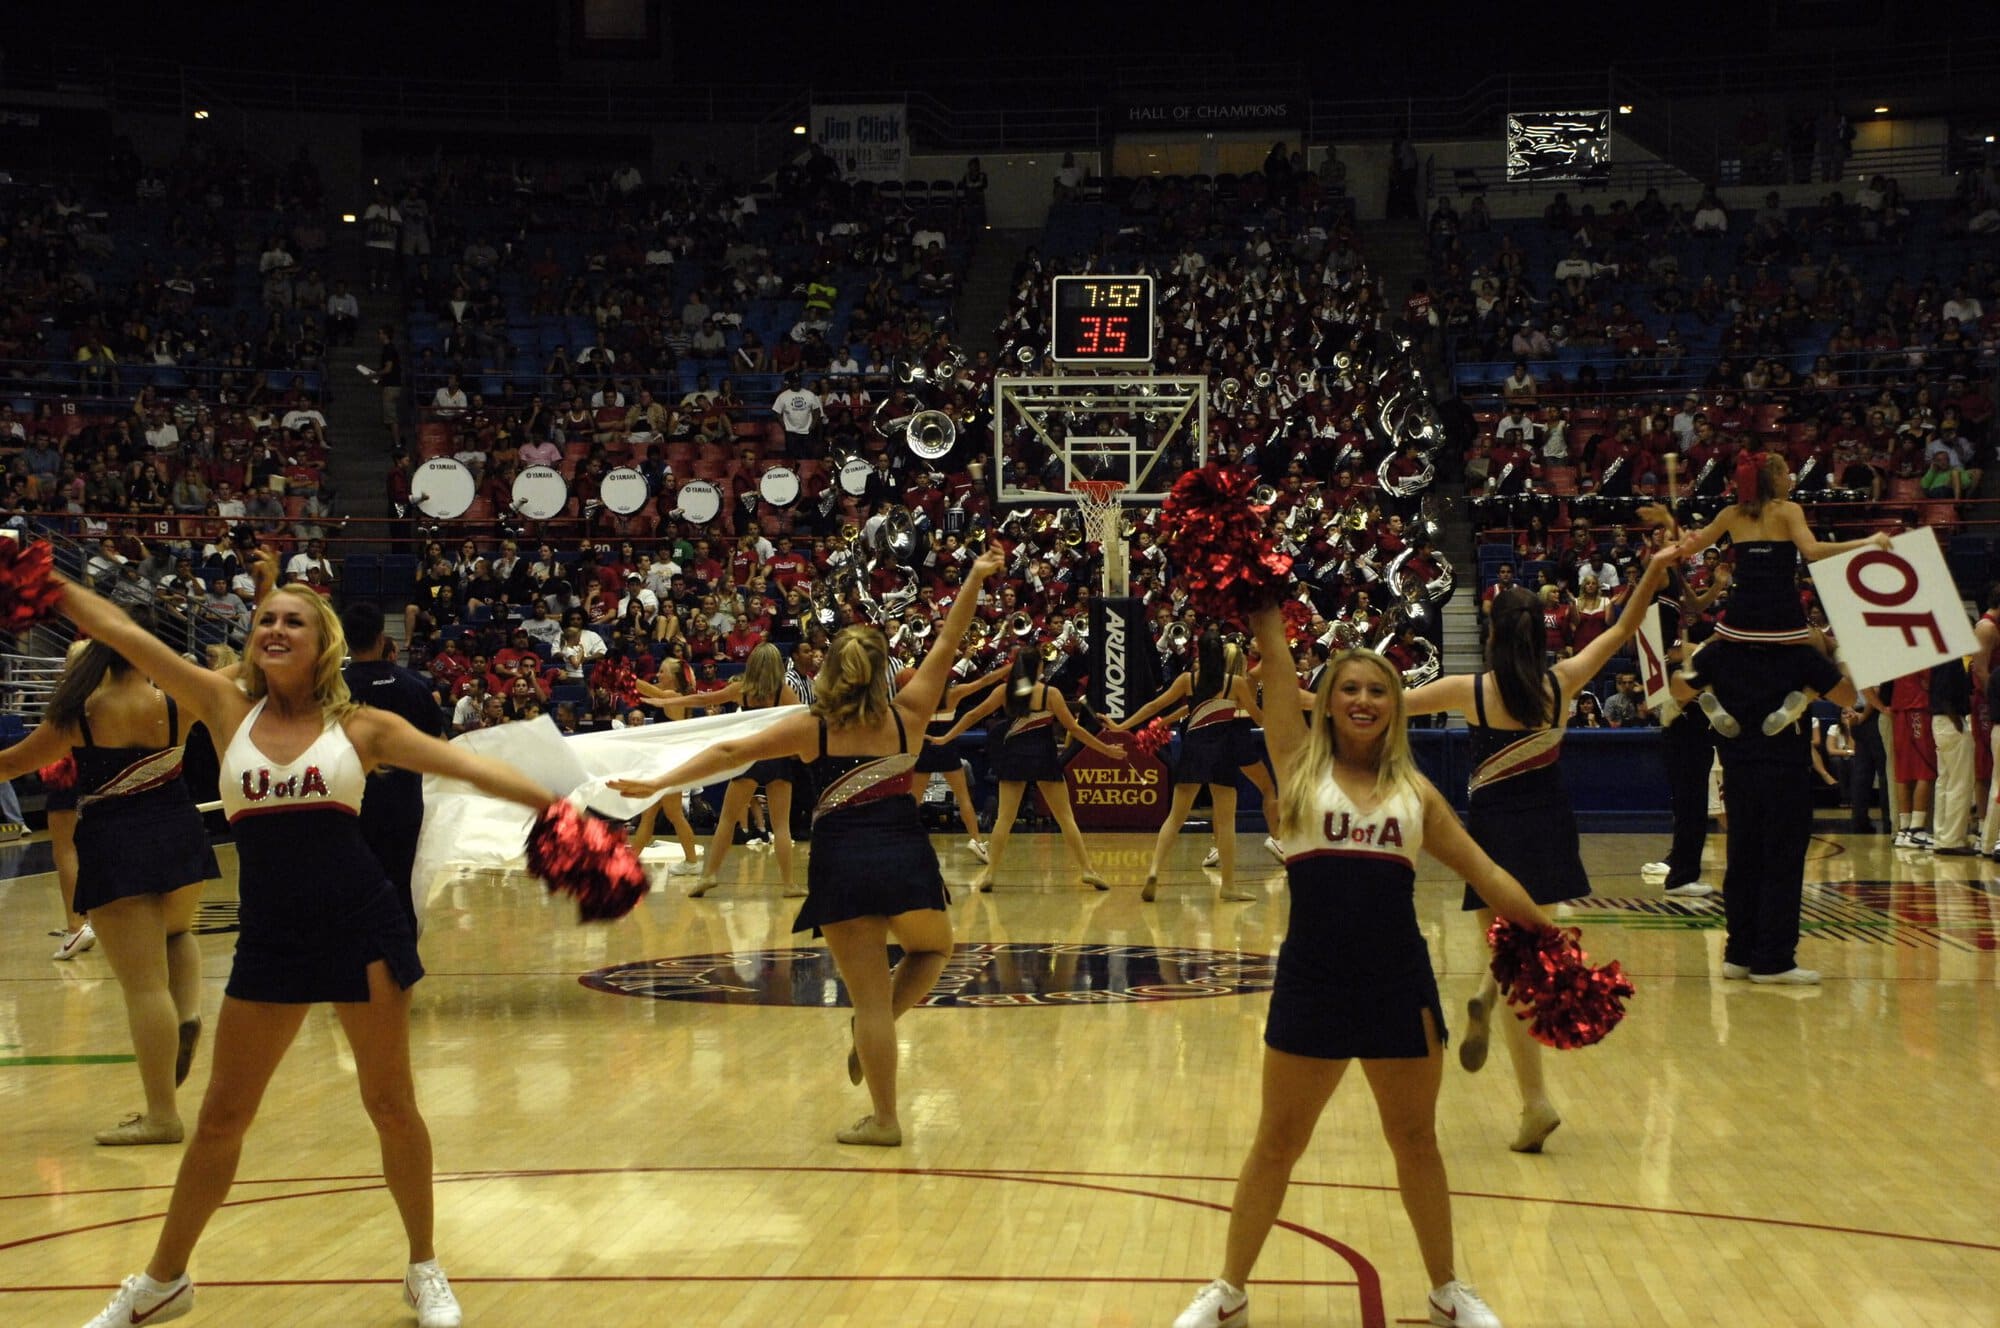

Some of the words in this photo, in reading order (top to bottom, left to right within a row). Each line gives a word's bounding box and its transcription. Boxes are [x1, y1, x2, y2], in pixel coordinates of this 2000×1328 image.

[1129, 106, 1166, 120] HALL
[1172, 105, 1192, 119] OF
[1196, 103, 1288, 119] CHAMPIONS
[819, 116, 850, 143] Jim
[857, 116, 899, 143] Click
[1084, 285, 1141, 308] 7:52
[1076, 315, 1129, 353] 35
[61, 402, 76, 415] 19
[435, 463, 457, 471] YAMAHA
[154, 520, 169, 535] 19
[1846, 550, 1949, 654] OF
[1105, 605, 1126, 719] ARIZONA
[242, 769, 269, 801] U
[275, 776, 297, 798] of
[300, 767, 328, 798] A
[1072, 768, 1160, 785] WELLS
[1075, 788, 1158, 805] FARGO
[1324, 812, 1349, 842] U
[1351, 824, 1376, 845] of
[1377, 817, 1403, 848] A
